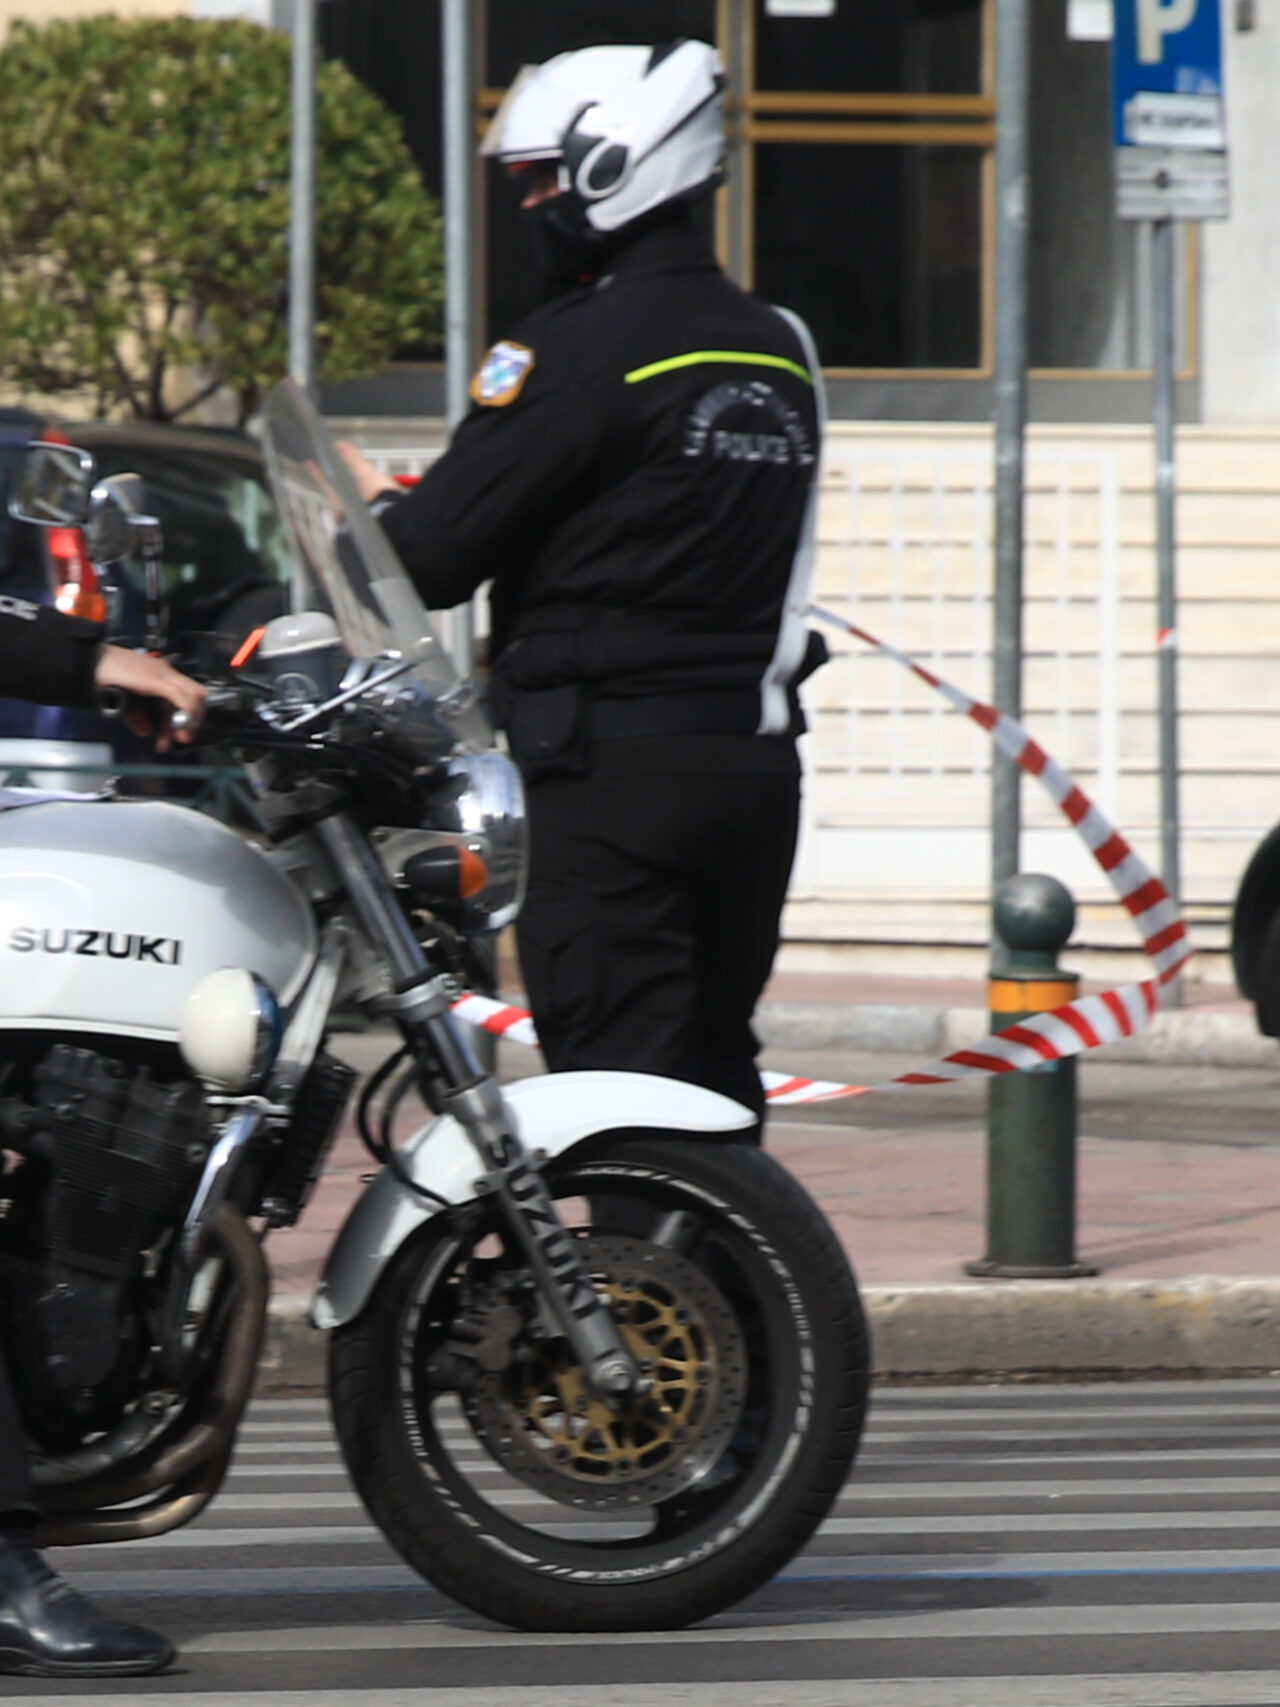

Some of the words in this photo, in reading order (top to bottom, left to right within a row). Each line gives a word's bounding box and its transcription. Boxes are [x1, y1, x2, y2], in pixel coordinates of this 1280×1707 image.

[714, 430, 789, 465] POLICE
[8, 926, 183, 966] SUZUKI
[487, 1133, 601, 1321] SUZUKI
